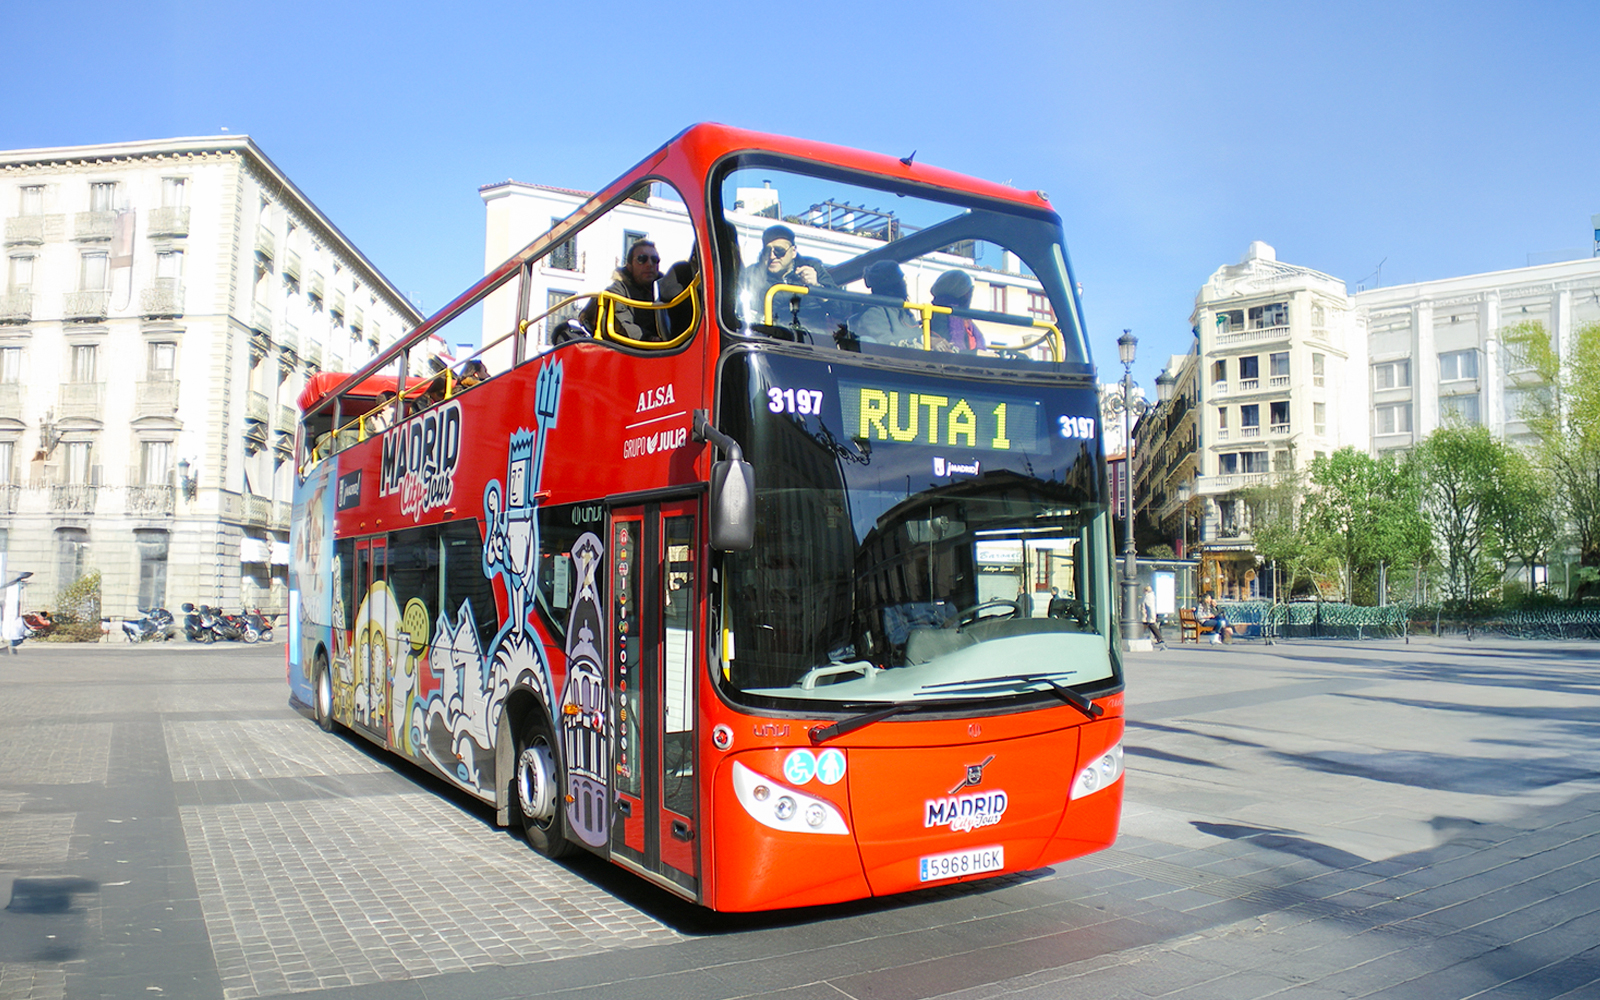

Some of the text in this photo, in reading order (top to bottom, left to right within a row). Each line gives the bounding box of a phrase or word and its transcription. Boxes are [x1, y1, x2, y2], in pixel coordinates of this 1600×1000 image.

[635, 383, 676, 413] ALSA
[767, 386, 824, 416] 3197
[859, 388, 1011, 450] RUTA 1
[1058, 414, 1095, 440] 3197
[379, 400, 461, 493] MADRID
[623, 436, 647, 460] GRUPO
[401, 470, 425, 523] City
[422, 462, 454, 512] Tour
[927, 792, 1006, 826] MADRID
[952, 812, 999, 831] City Tour
[930, 855, 969, 877] 5968
[972, 850, 1000, 871] HGK
